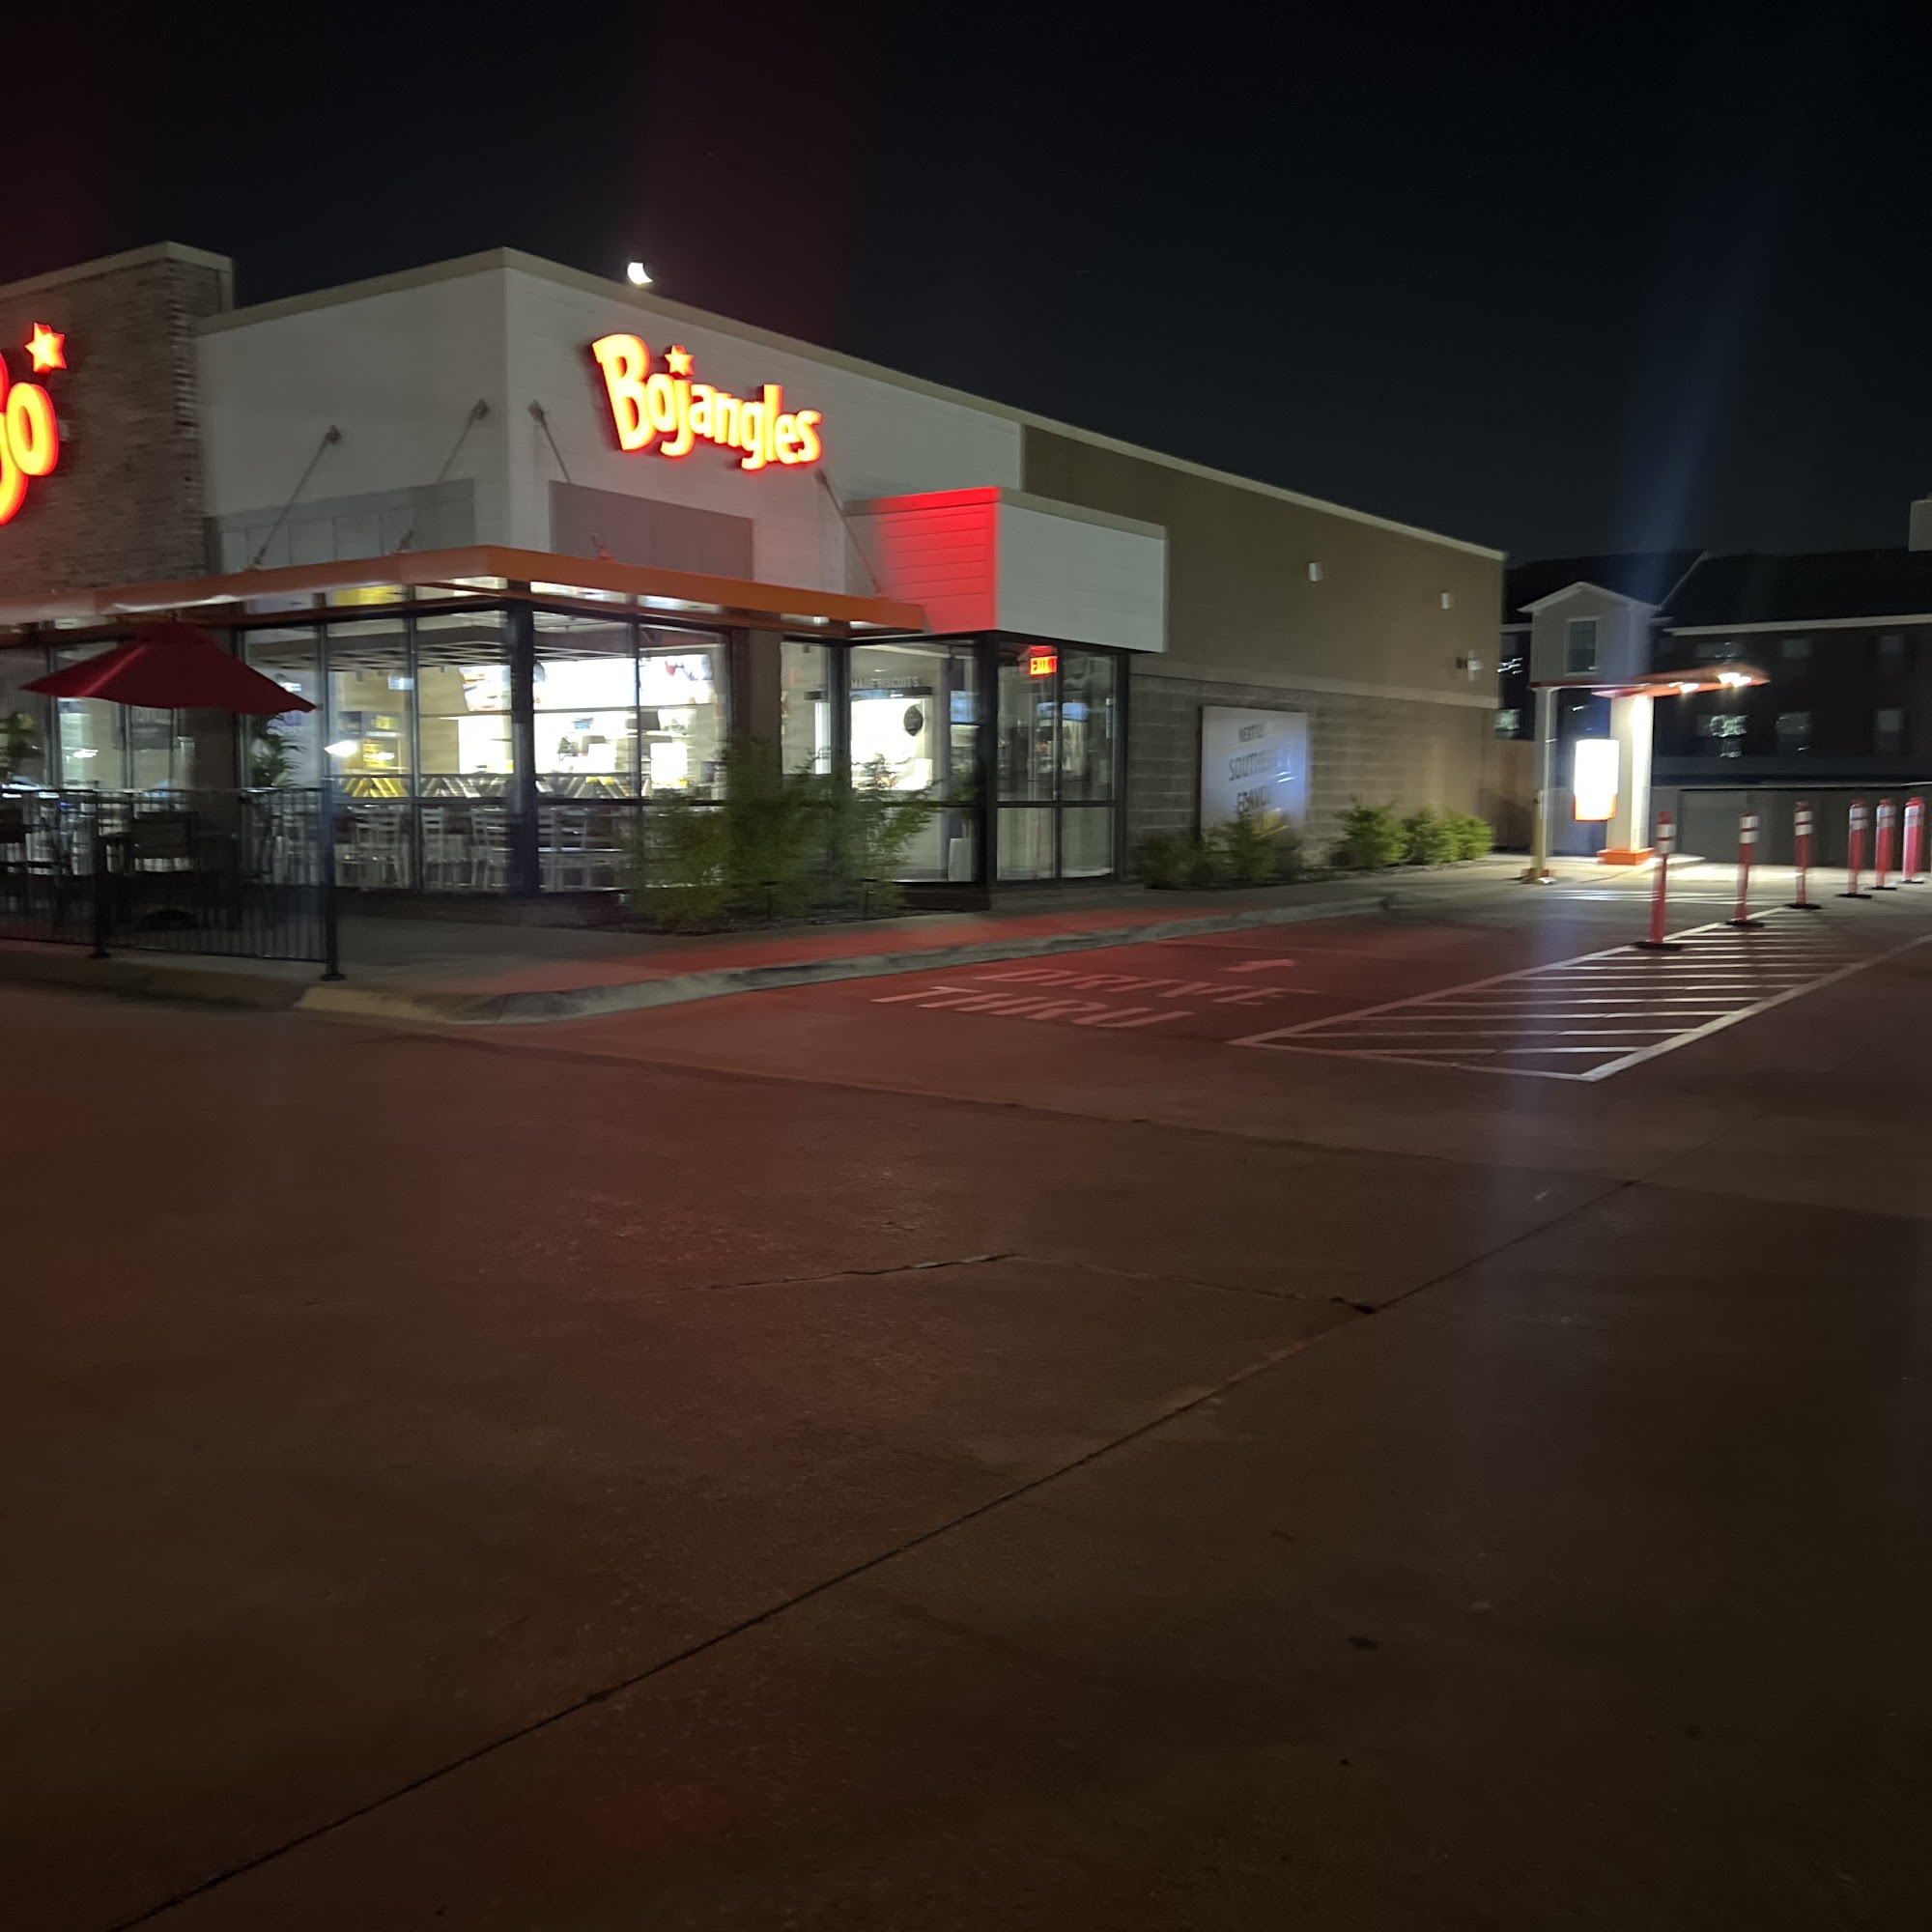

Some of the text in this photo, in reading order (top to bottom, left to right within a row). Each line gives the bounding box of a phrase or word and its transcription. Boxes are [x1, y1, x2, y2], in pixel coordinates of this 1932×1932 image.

[592, 333, 822, 470] Bojangles
[870, 986, 1197, 1028] THRU
[970, 968, 1319, 1006] DRIVE
